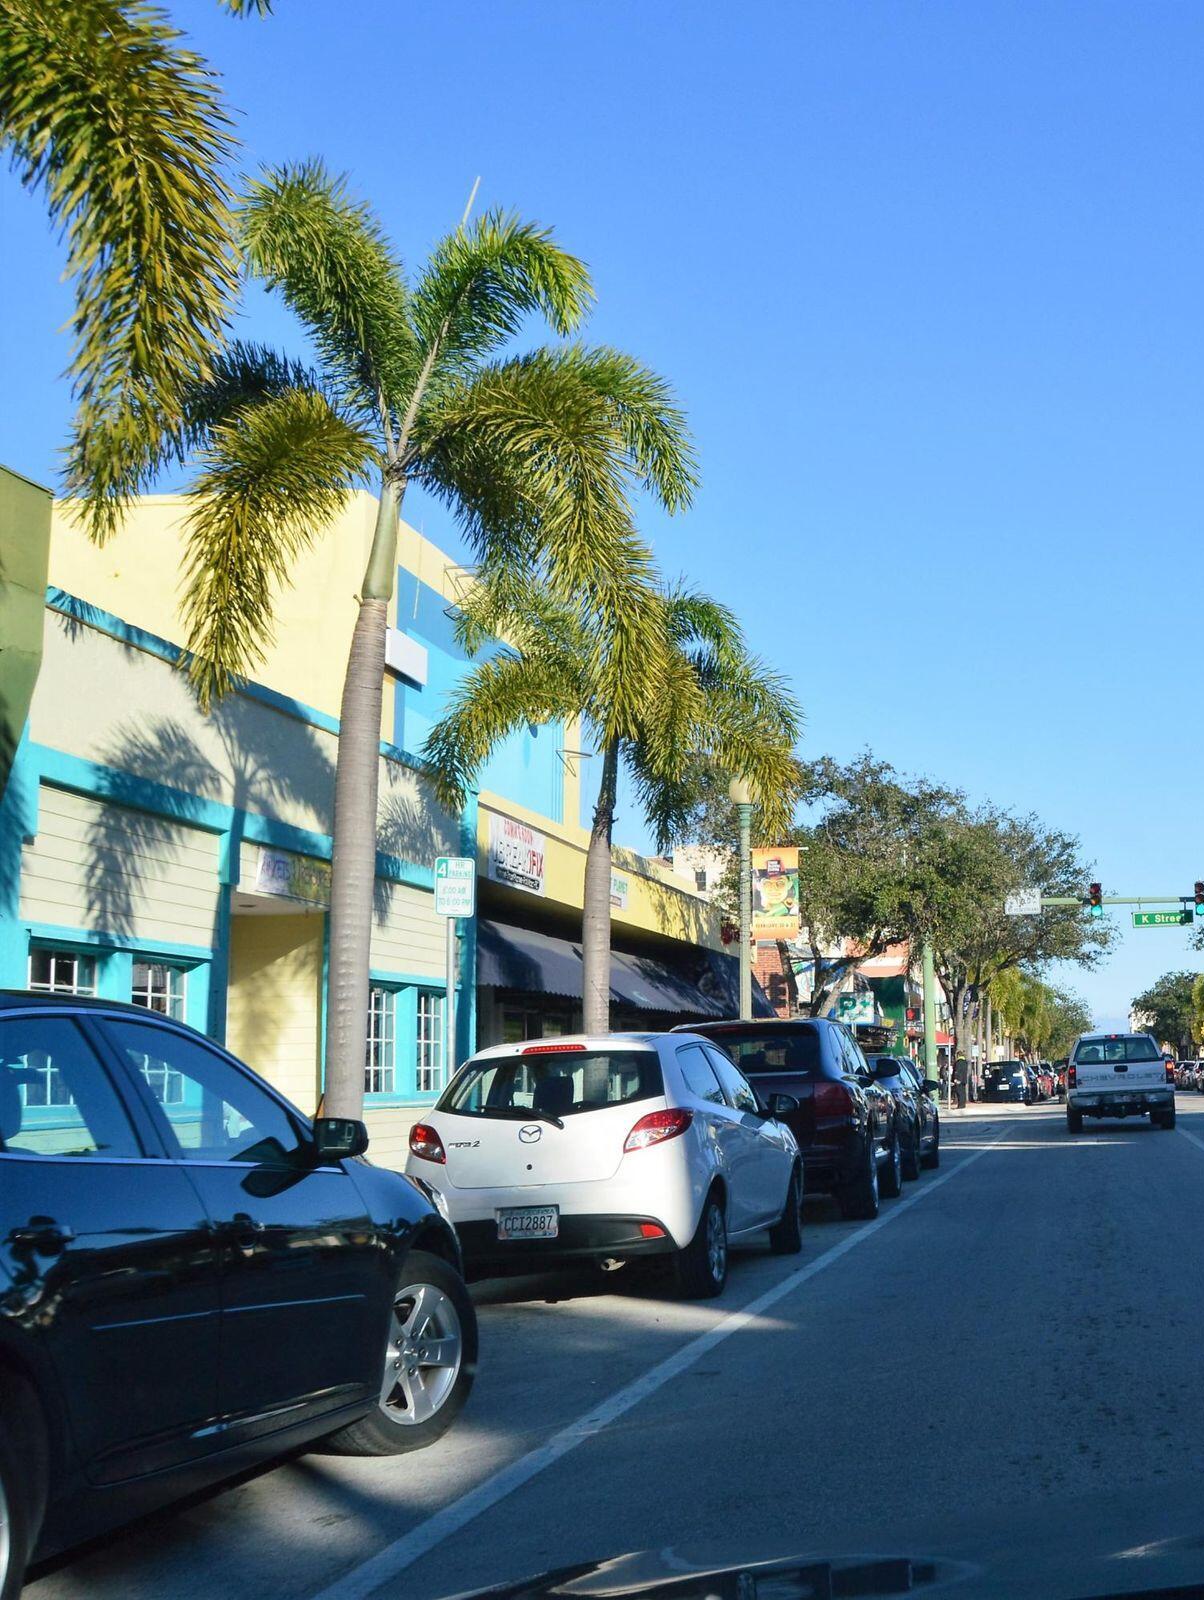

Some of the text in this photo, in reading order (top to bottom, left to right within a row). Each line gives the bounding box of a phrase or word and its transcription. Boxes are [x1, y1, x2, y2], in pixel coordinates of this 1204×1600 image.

[437, 862, 448, 877] 4
[1141, 914, 1182, 923] K Stree
[1080, 1072, 1165, 1082] CHEVROLET
[503, 1215, 553, 1232] CCI2887
